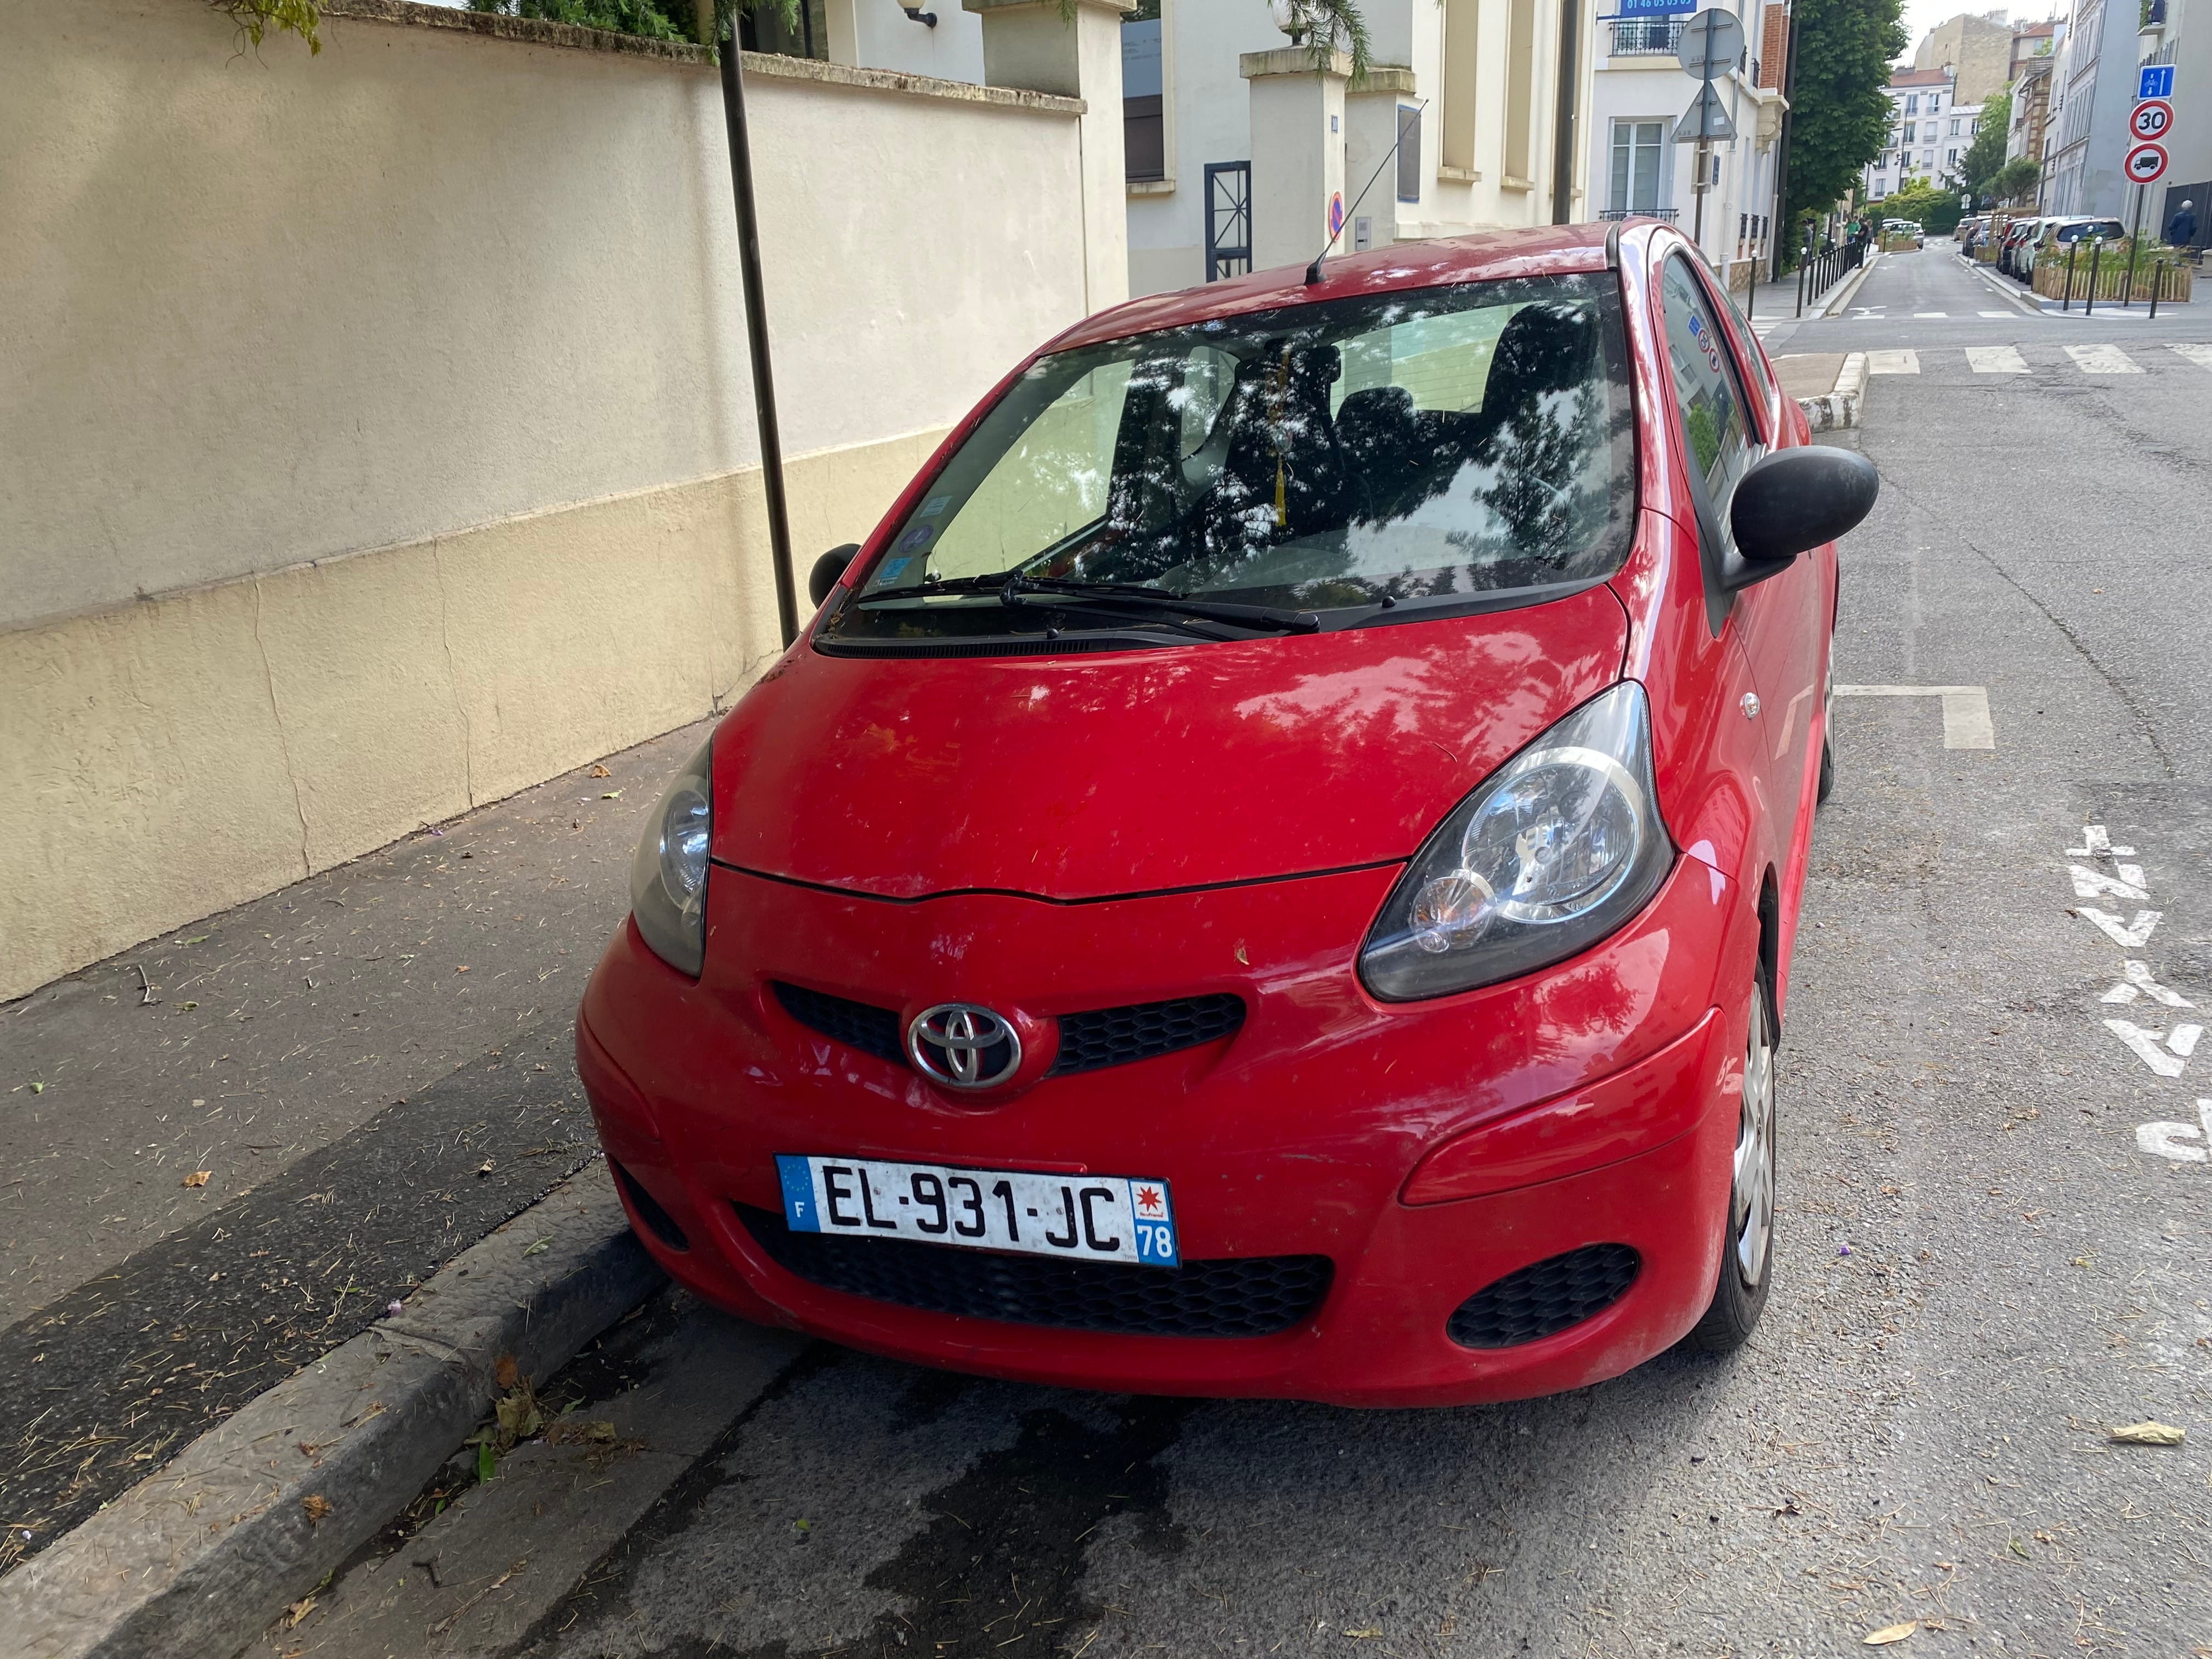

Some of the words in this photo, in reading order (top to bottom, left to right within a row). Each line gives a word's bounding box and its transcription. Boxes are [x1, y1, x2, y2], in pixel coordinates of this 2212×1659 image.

[2138, 111, 2165, 130] 30
[794, 1201, 805, 1218] F
[1137, 1224, 1172, 1258] 78
